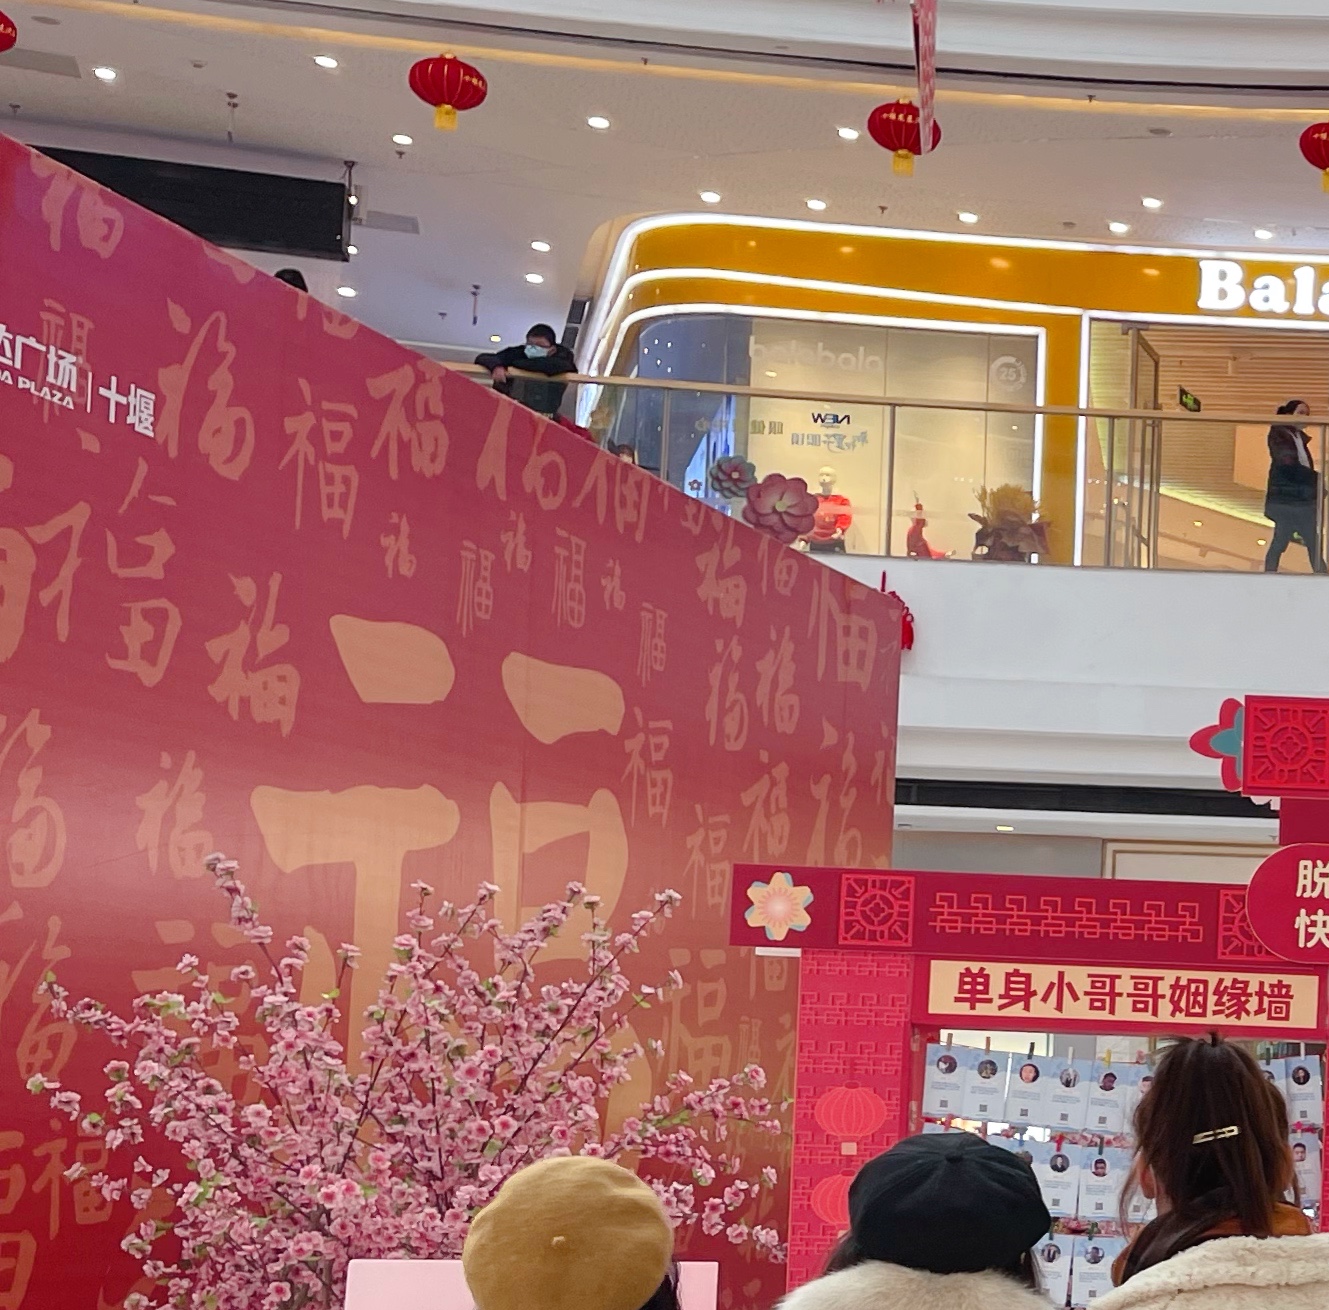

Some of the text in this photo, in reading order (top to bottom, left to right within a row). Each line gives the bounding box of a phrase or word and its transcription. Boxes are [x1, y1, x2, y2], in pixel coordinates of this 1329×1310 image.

[18, 376, 74, 410] PLAZA
[99, 375, 156, 437] 十堰
[279, 377, 359, 540] 福
[456, 539, 496, 638] 福
[552, 526, 586, 629] 福
[637, 602, 667, 687] 福
[621, 707, 673, 828] 福
[683, 804, 731, 920] 福
[953, 967, 1294, 1023] 单身小哥哥姻缘墙
